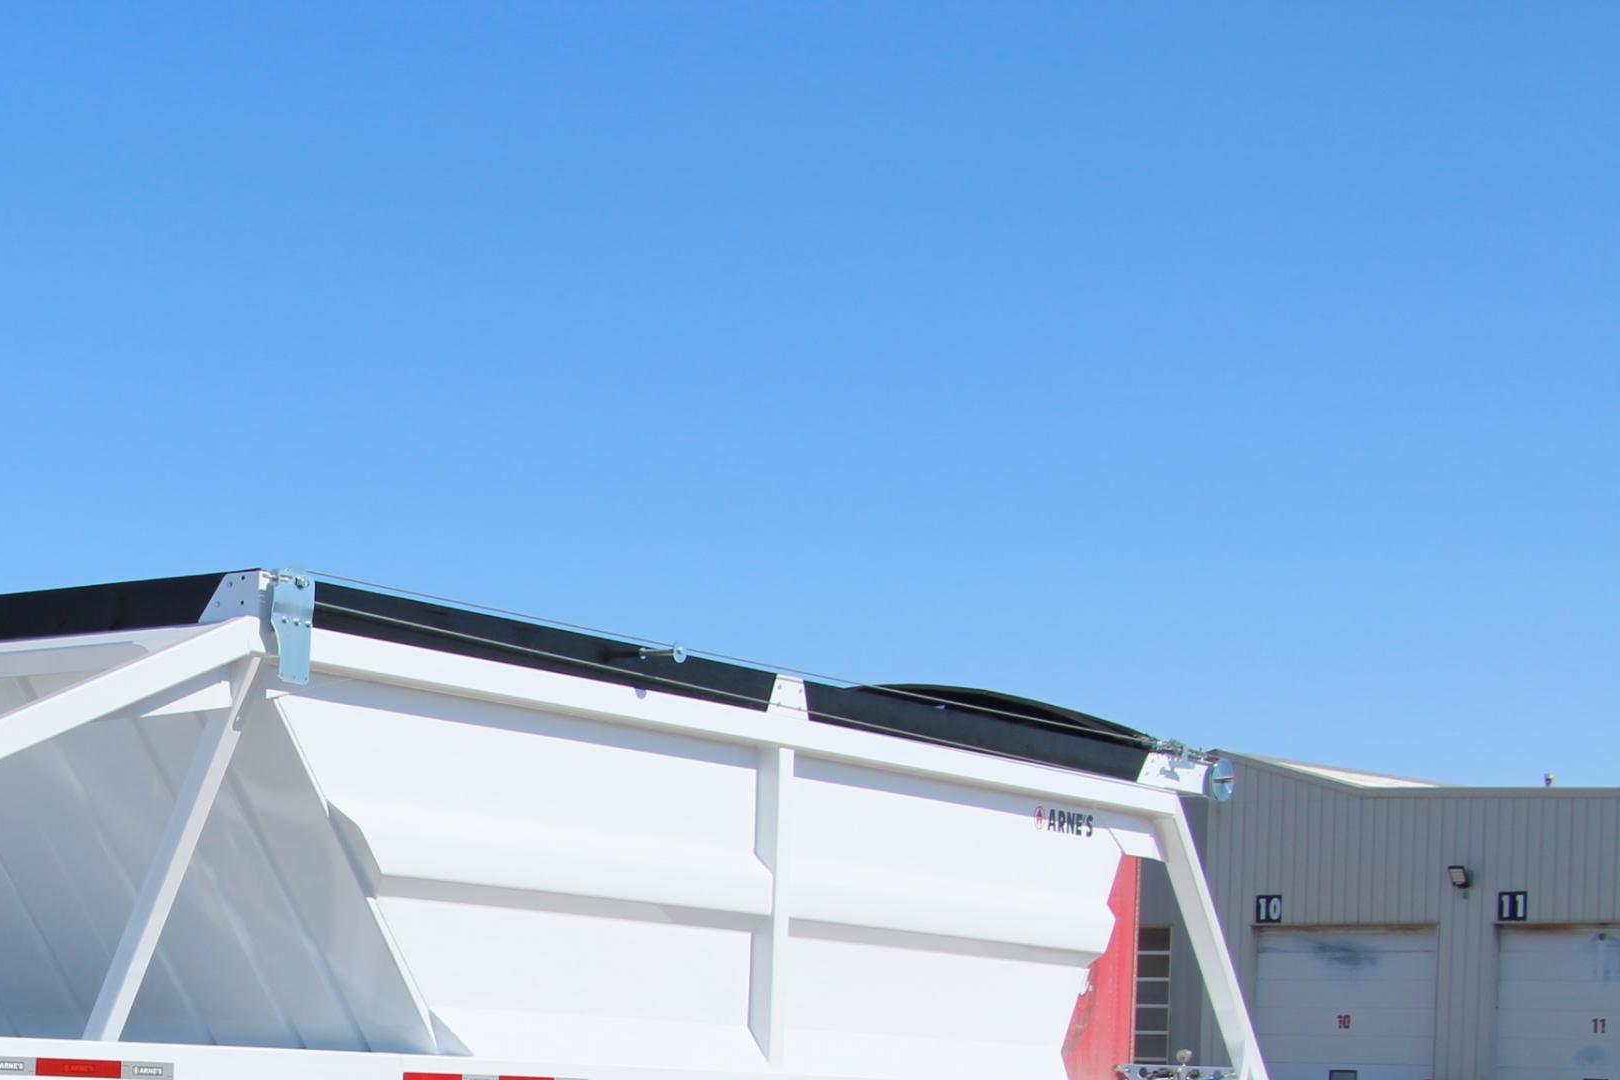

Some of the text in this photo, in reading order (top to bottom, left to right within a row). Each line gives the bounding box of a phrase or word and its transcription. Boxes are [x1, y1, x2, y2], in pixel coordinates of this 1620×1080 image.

[1047, 809, 1094, 837] ARNE'S
[1259, 897, 1281, 920] 10
[1501, 895, 1524, 917] 11
[1337, 1014, 1351, 1029] 10
[1591, 1018, 1606, 1033] 11
[0, 1062, 23, 1070] ARNE'S
[139, 1067, 162, 1075] ARNE'S
